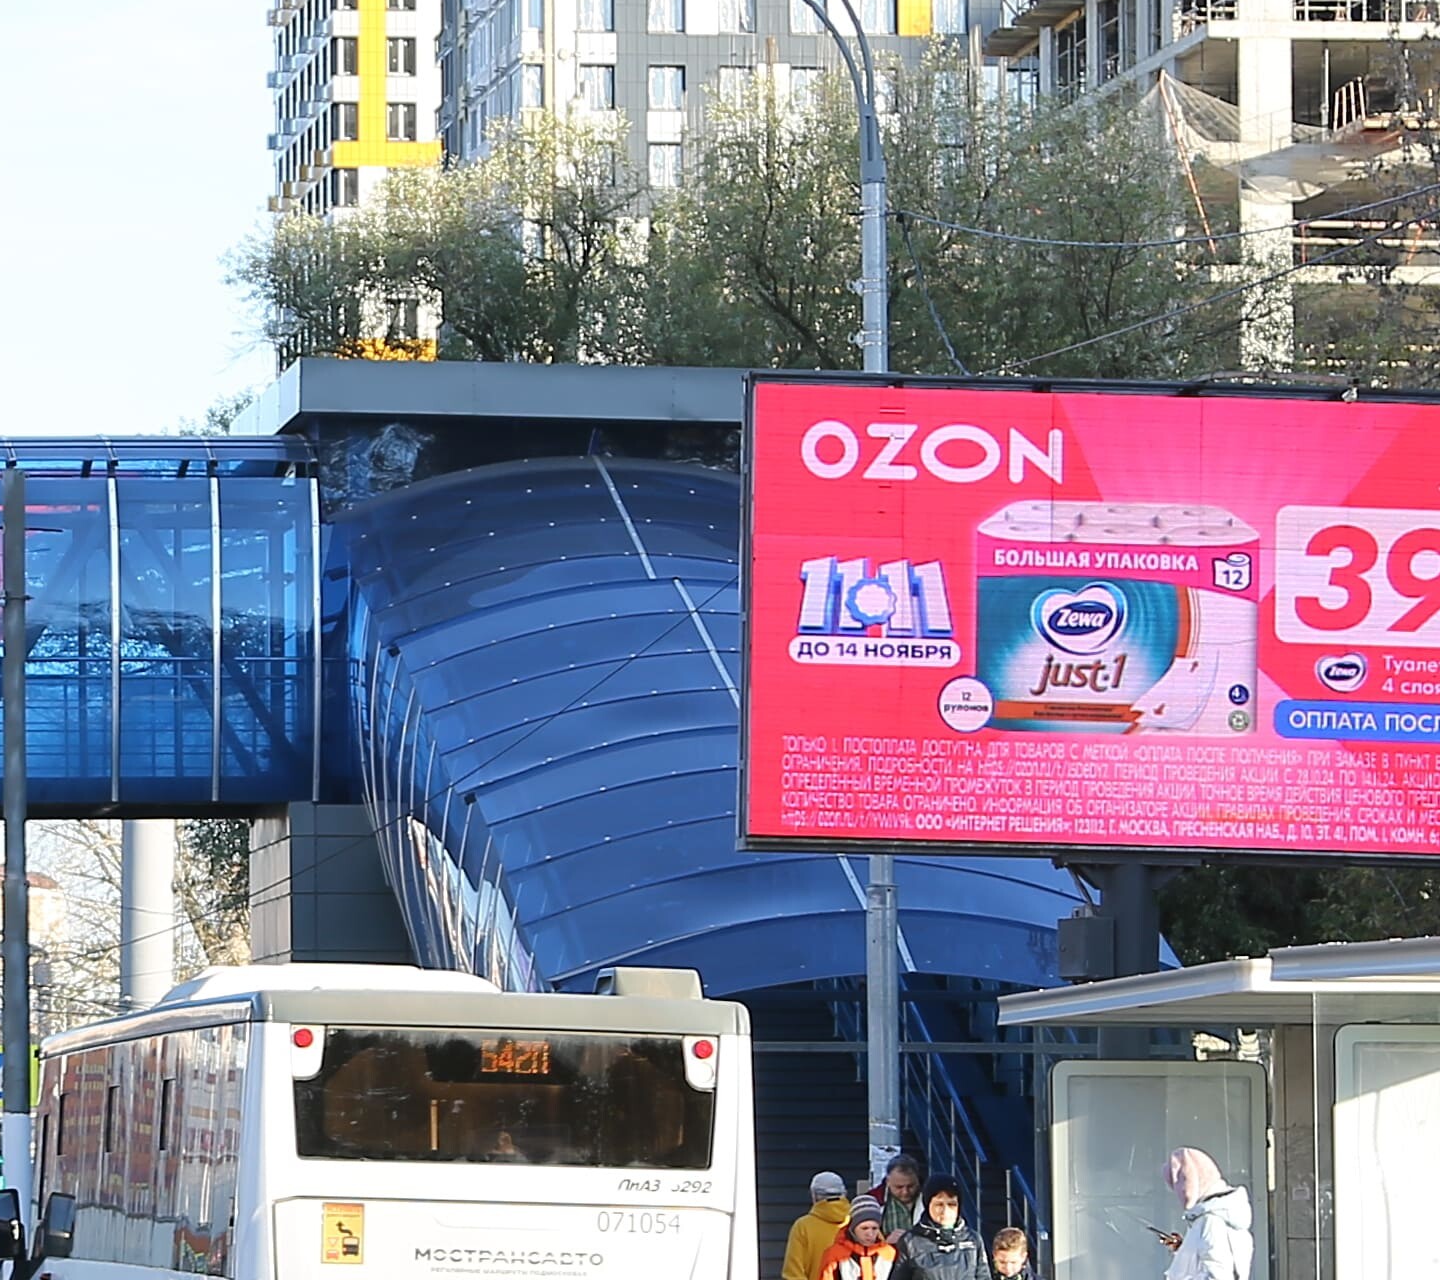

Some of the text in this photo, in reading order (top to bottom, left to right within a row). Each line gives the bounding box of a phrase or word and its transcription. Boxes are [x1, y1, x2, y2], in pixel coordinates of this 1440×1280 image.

[801, 420, 1063, 484] OZON
[994, 548, 1199, 572] БОЛЬШАЯ УПАКОВКА
[1223, 569, 1244, 586] 12
[1056, 607, 1107, 629] Zewa
[797, 641, 952, 661] ДО 14 НОЯБРЯ
[1382, 680, 1394, 693] 4
[1289, 710, 1377, 732] ОПЛАТА
[597, 1211, 681, 1234] 071054
[414, 1248, 604, 1266] МОСТРАНСАВТО
